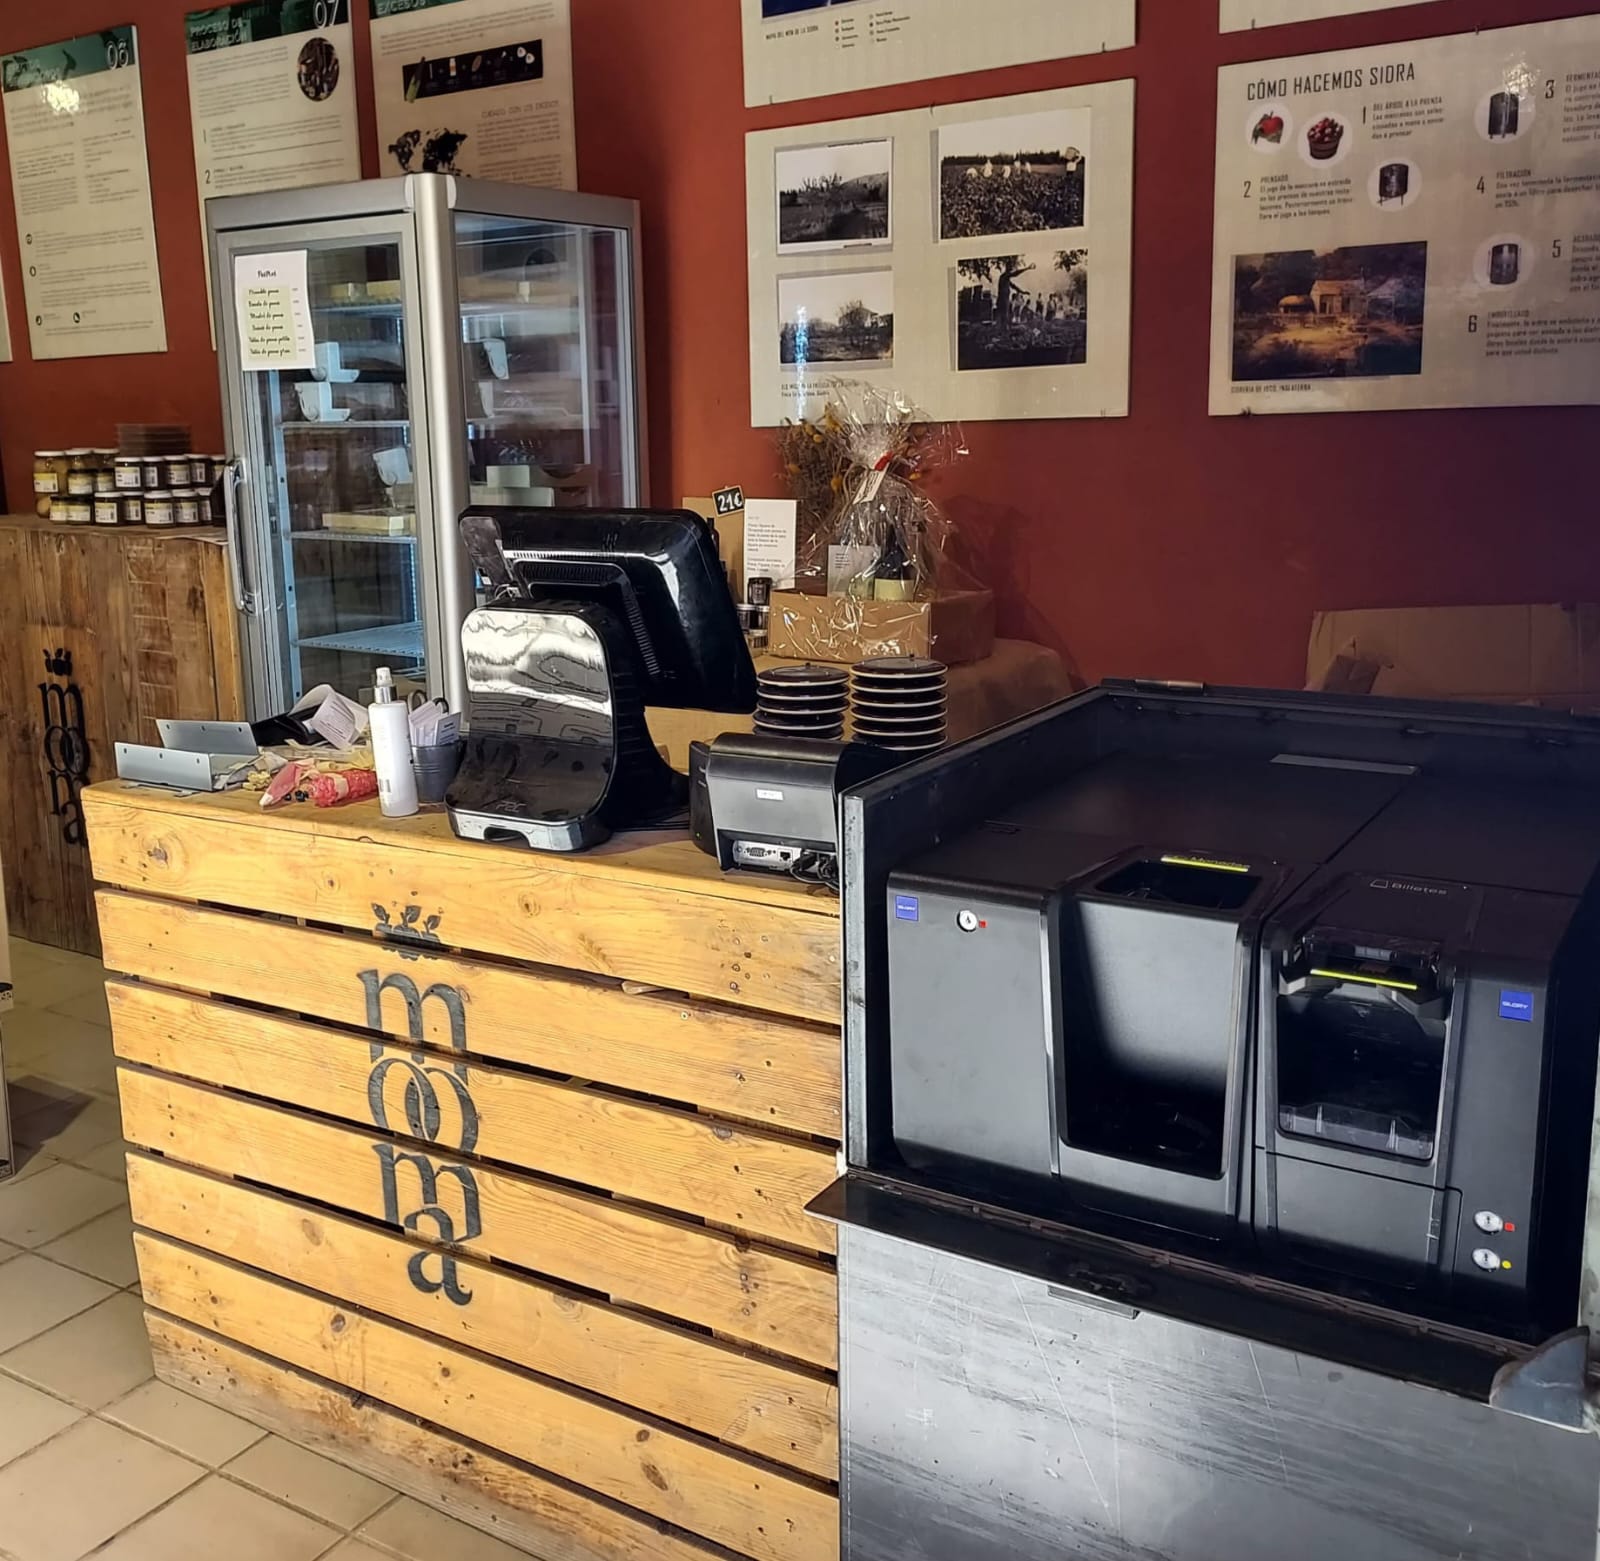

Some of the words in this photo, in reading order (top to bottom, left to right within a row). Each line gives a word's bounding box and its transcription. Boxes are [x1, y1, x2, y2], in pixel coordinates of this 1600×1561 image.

[1247, 78, 1287, 101] CÓMO
[1294, 69, 1363, 94] HACEMOS
[1369, 62, 1415, 87] SIDRA
[1545, 79, 1555, 99] 3
[1243, 180, 1251, 198] 2
[1476, 176, 1485, 194] 4
[1552, 239, 1561, 258] 5
[1468, 314, 1478, 333] 6
[717, 492, 743, 512] 21€
[1391, 882, 1448, 896] Billetes
